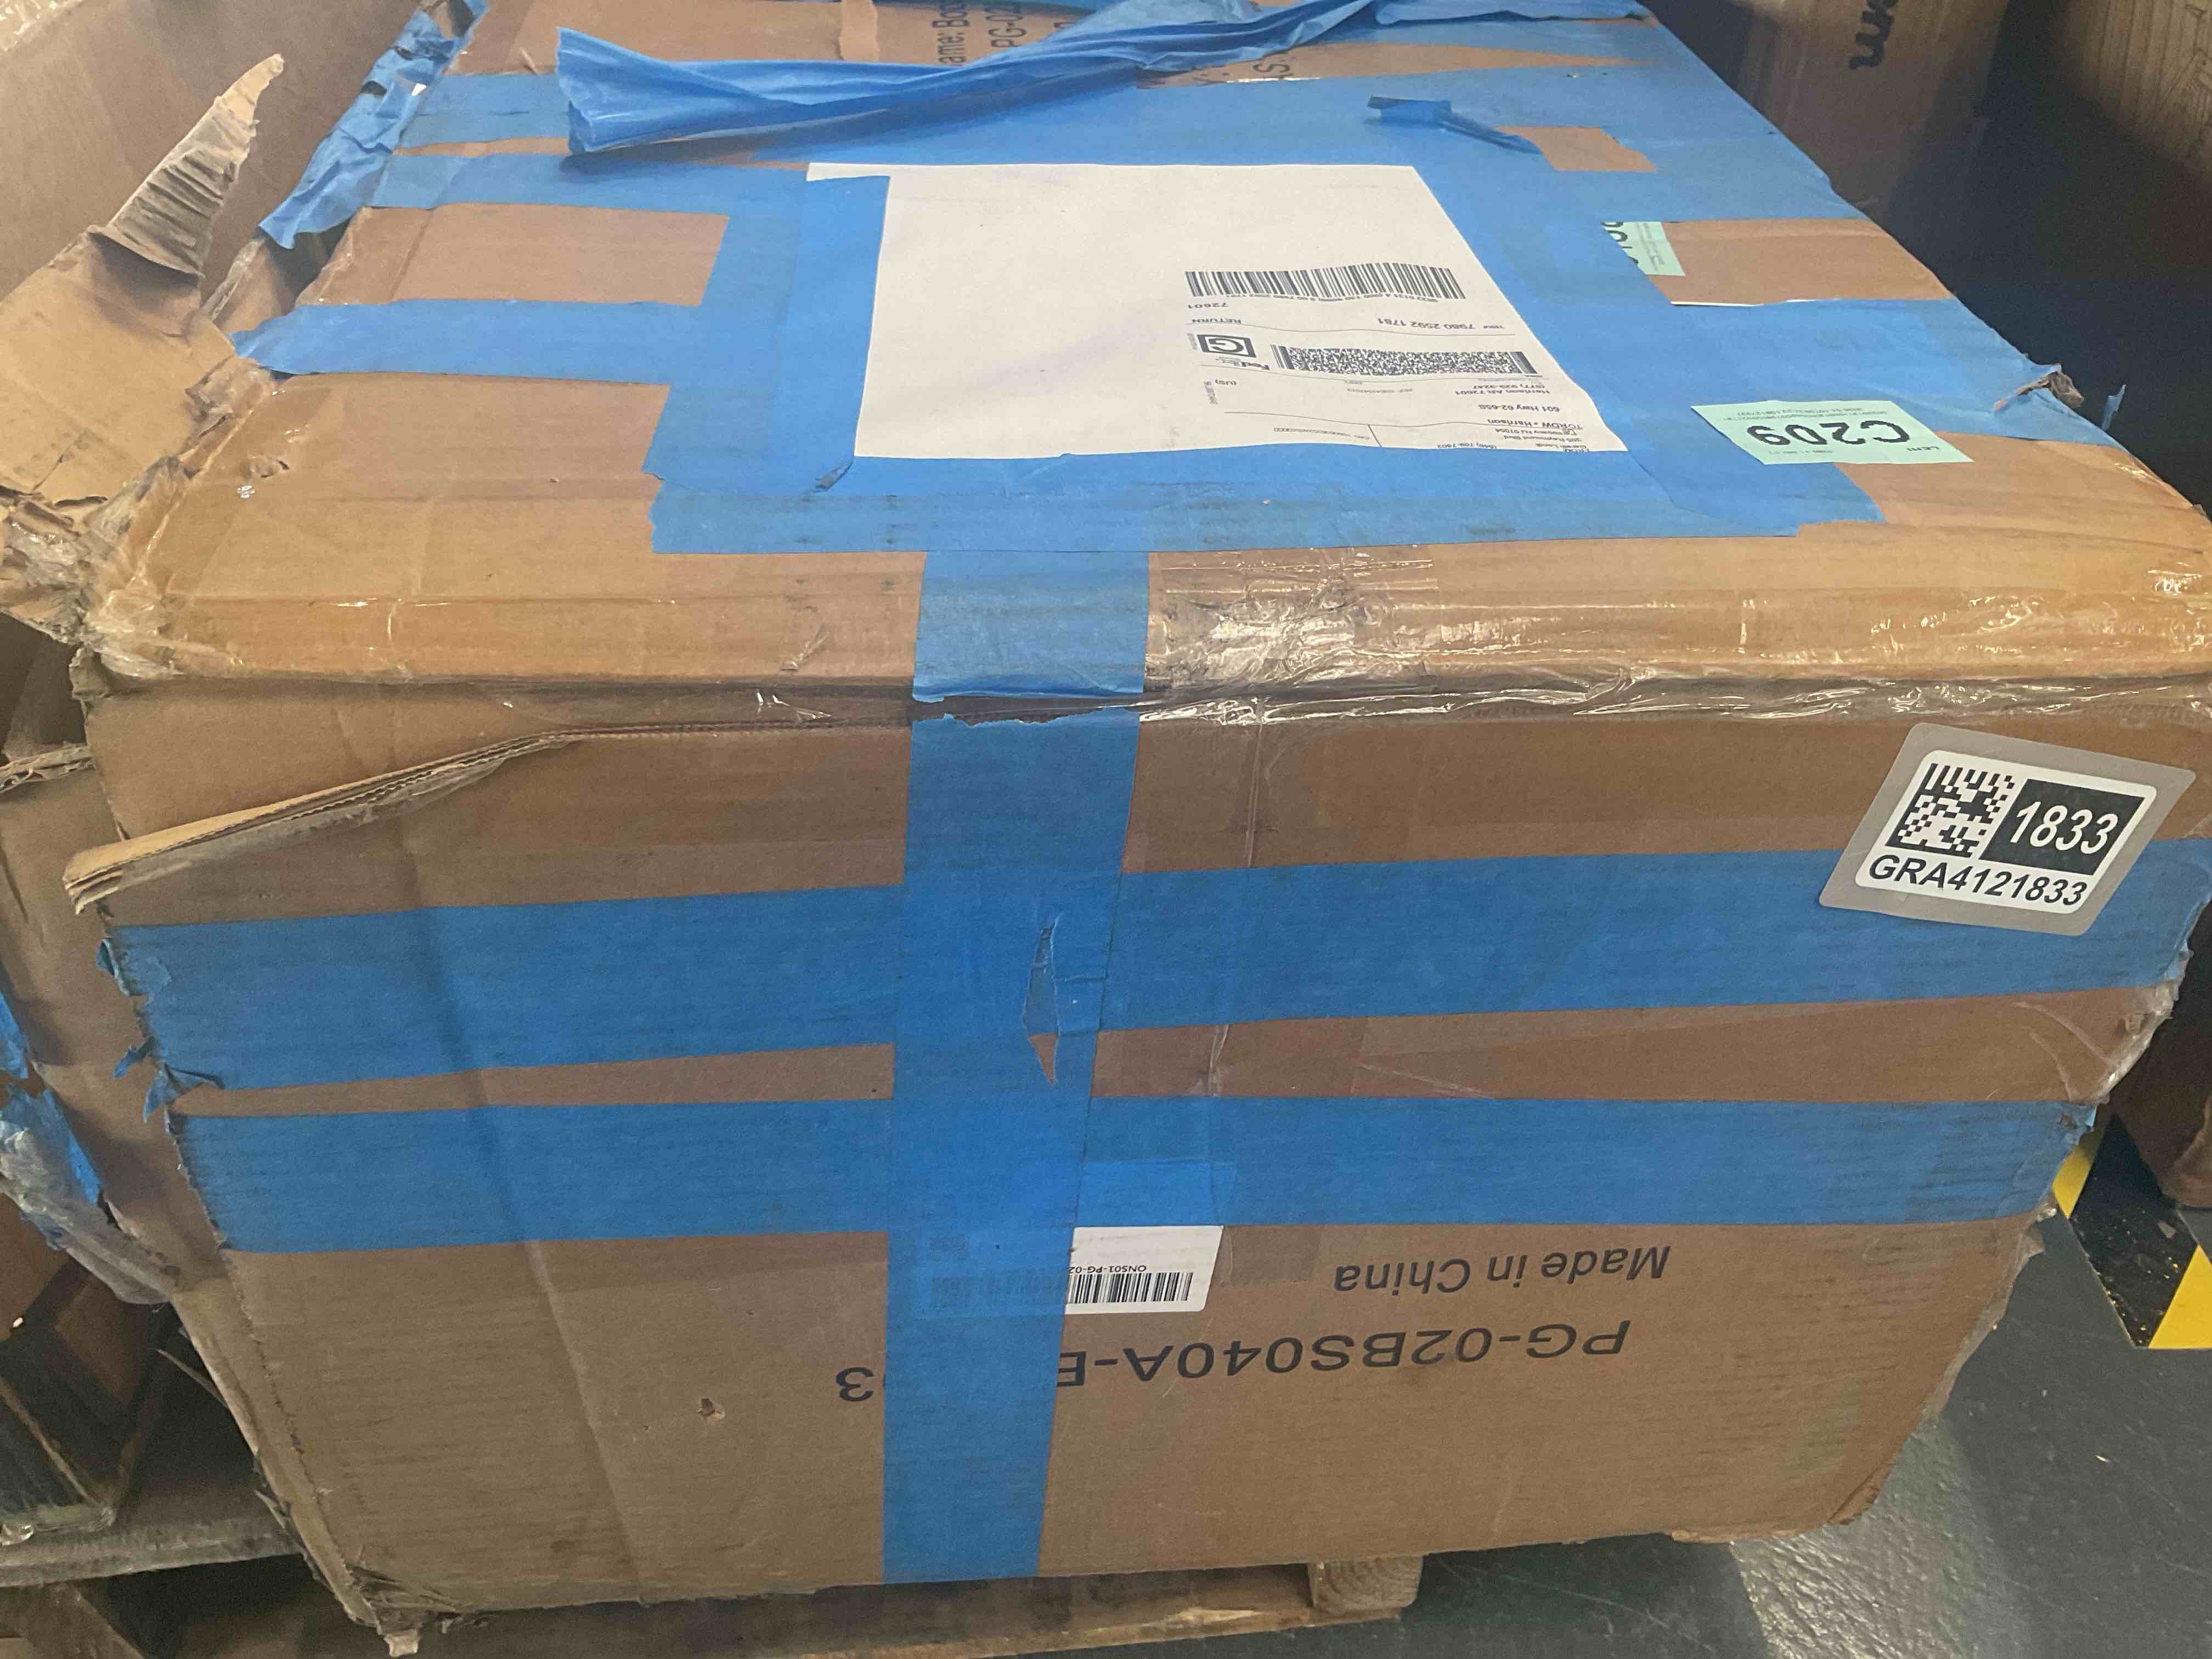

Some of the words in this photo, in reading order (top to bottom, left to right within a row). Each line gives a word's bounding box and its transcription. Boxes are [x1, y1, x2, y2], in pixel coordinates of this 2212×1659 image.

[937, 32, 967, 64] ame:
[1209, 338, 1244, 353] G
[1747, 420, 1910, 445] C209
[2010, 801, 2119, 854] 1833
[1868, 854, 2088, 905] GRA4121833
[1068, 1265, 1147, 1273] ONS01-PG-02
[1334, 1259, 1471, 1296] China
[1487, 1254, 1528, 1288] in
[1541, 1246, 1671, 1285] Made
